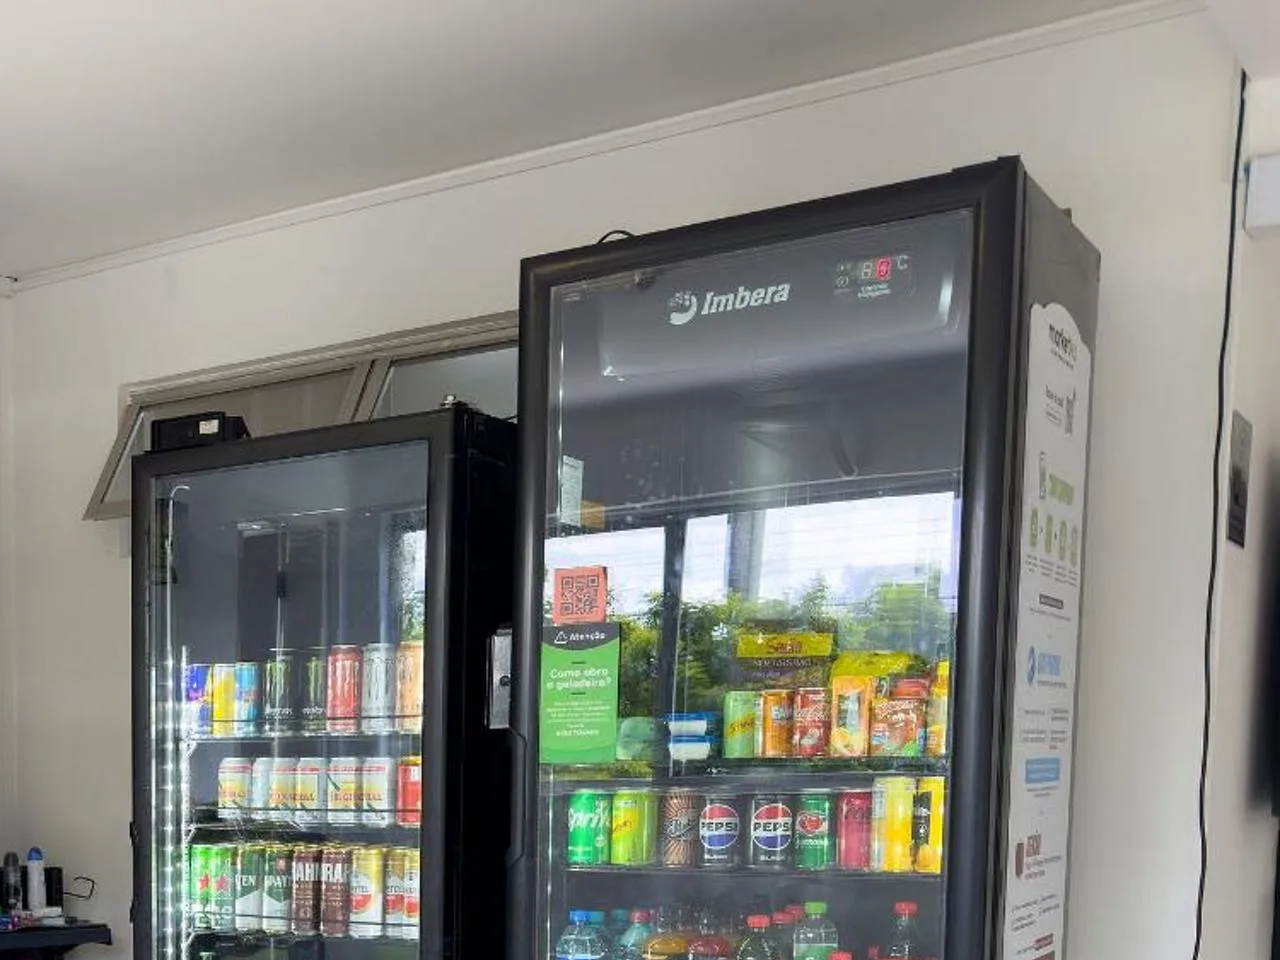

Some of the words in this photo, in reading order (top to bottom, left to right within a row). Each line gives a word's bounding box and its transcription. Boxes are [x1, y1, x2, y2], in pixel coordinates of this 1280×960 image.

[701, 283, 791, 317] Imbera
[549, 668, 581, 679] Como
[701, 821, 738, 832] PEPSI
